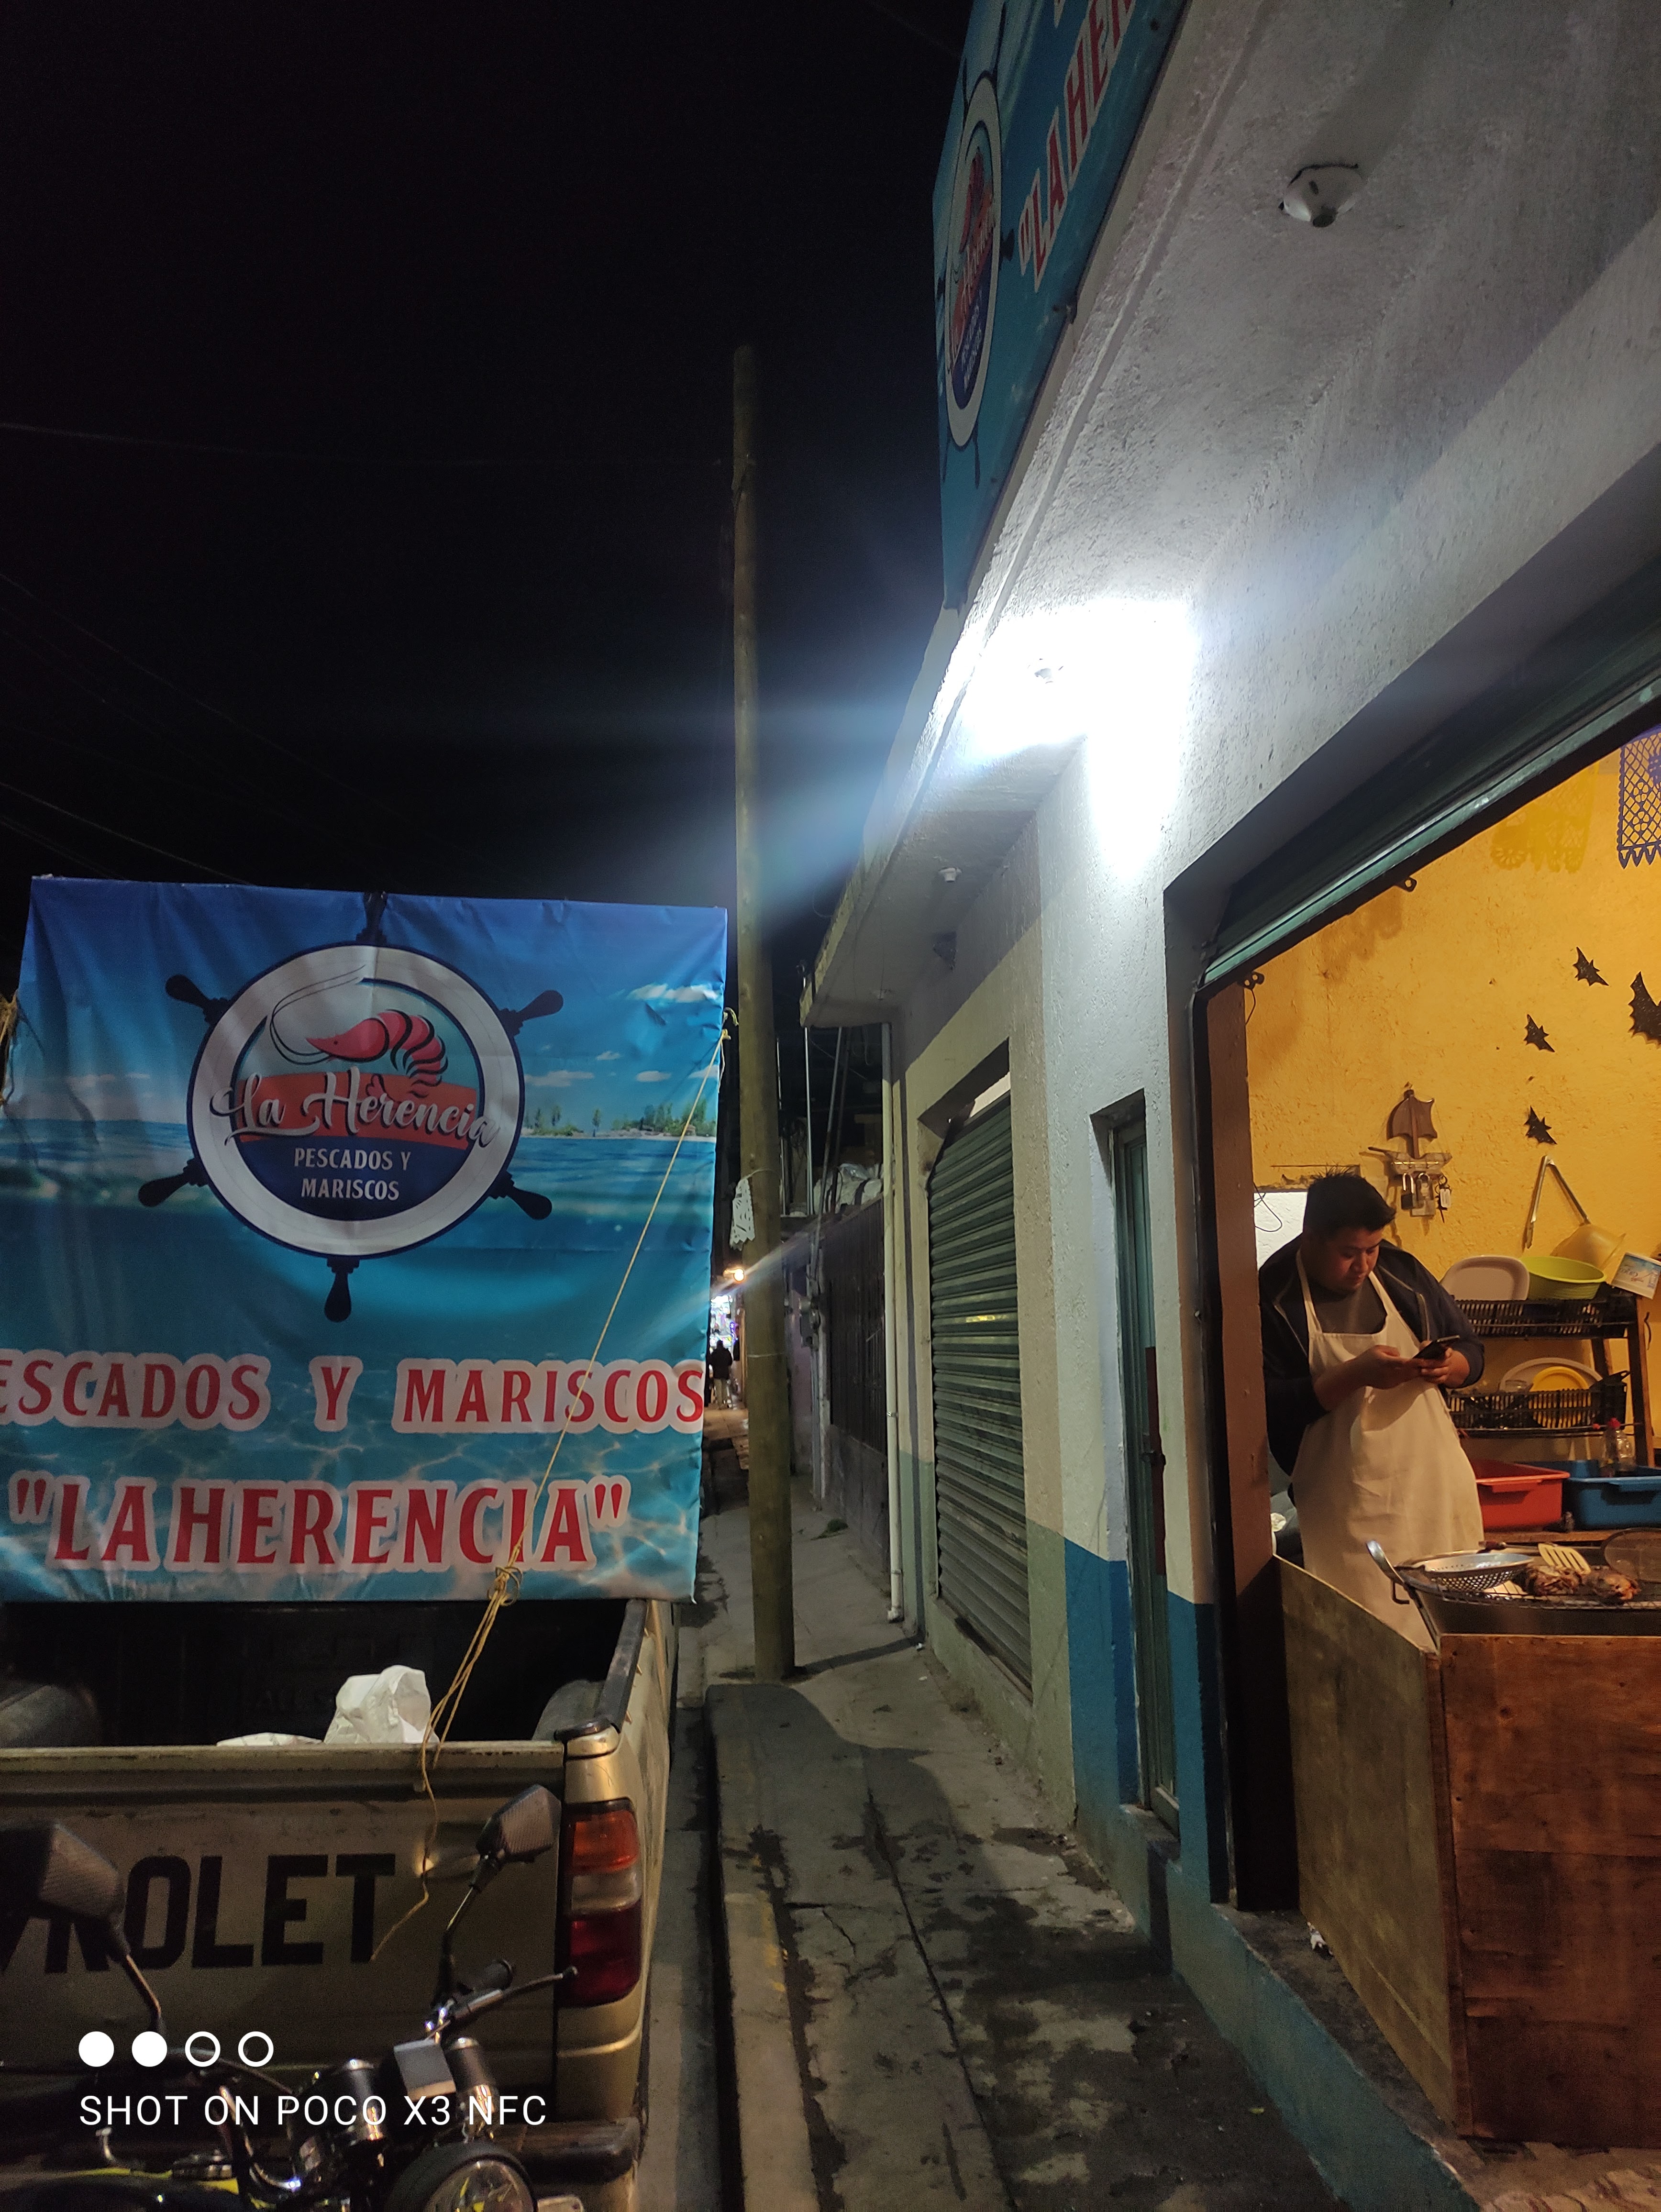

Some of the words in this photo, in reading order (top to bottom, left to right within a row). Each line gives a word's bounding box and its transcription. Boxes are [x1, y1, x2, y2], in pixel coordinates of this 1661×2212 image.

[210, 1073, 316, 1145] La
[301, 1066, 501, 1148] Herencia
[294, 1148, 393, 1171] PESCADOS
[401, 1151, 411, 1171] Y
[301, 1179, 400, 1201] MARISCOS
[321, 1367, 351, 1420] Y
[402, 1370, 703, 1423] MARISCOS
[0, 1853, 395, 1974] OLET
